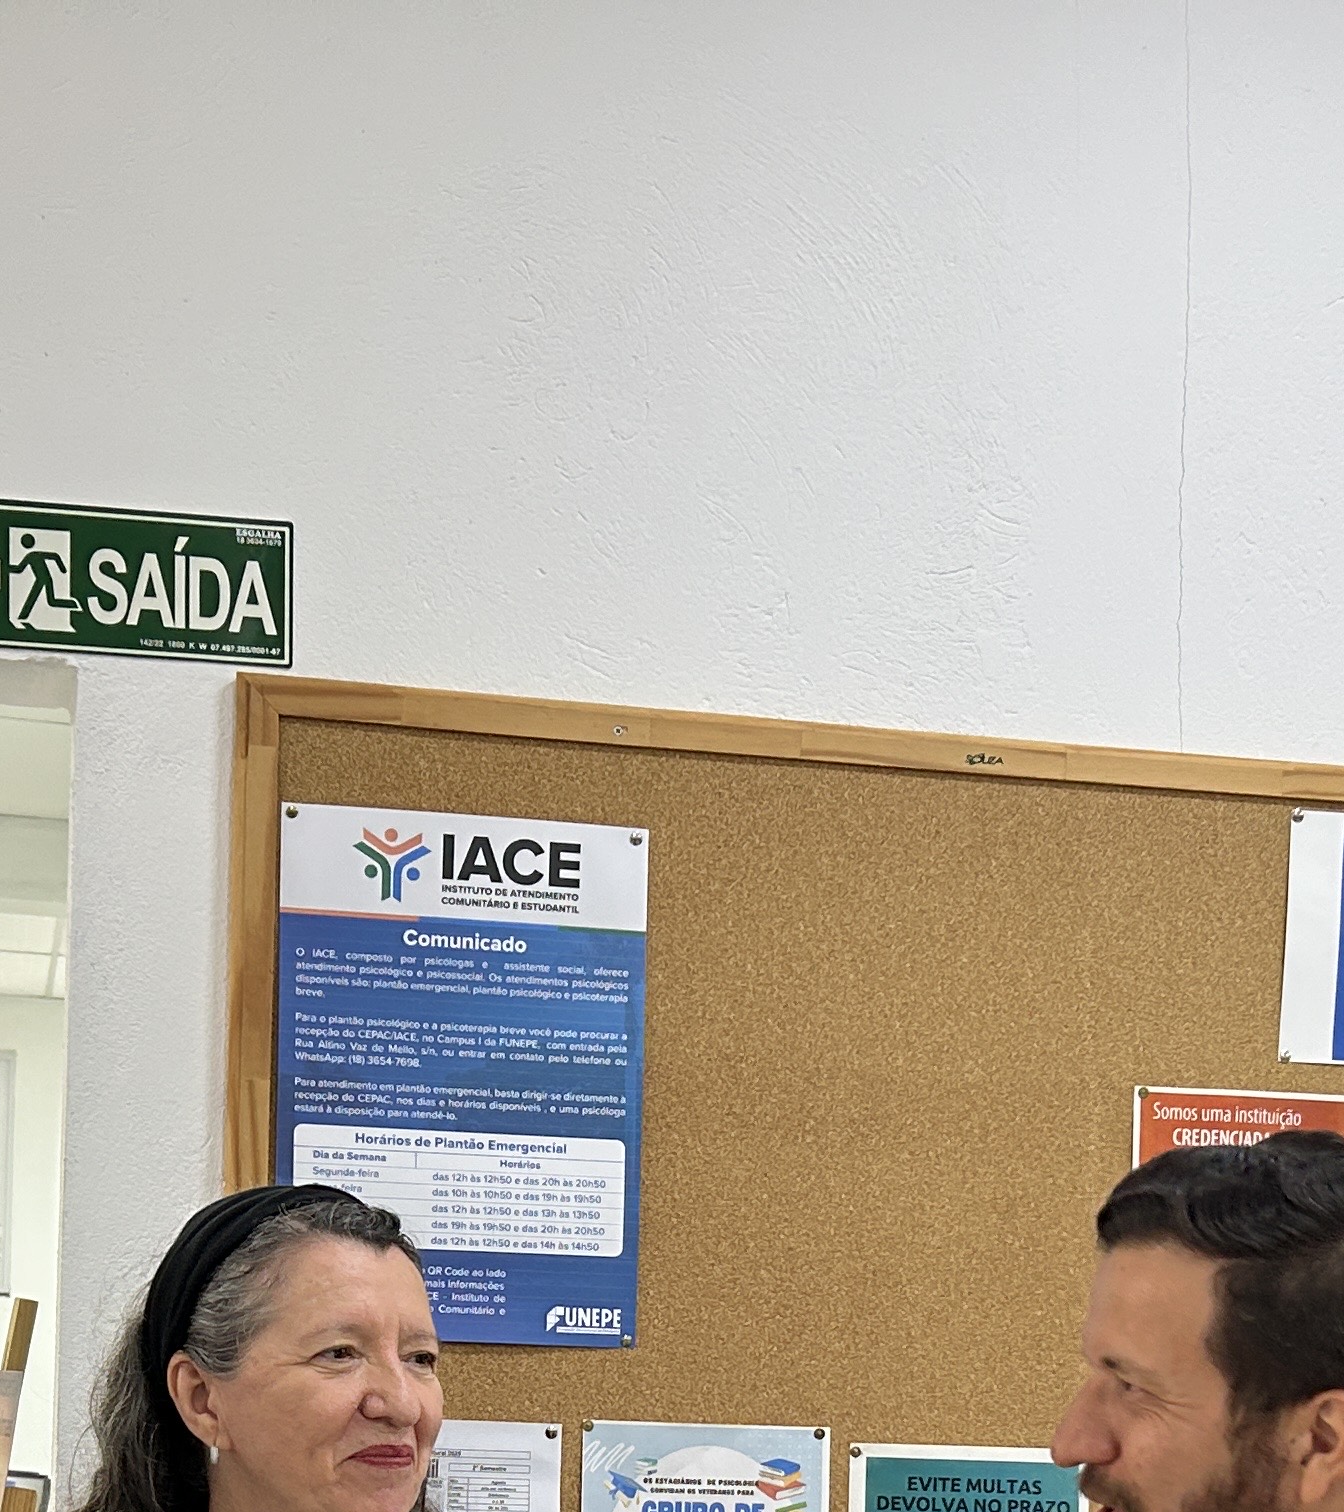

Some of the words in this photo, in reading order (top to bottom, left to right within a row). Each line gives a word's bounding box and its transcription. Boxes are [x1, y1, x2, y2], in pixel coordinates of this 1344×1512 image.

[87, 536, 278, 635] SAÍDA
[442, 834, 581, 888] IACE
[442, 885, 492, 896] INSTITUTO
[495, 888, 507, 896] DE
[510, 890, 579, 901] ATENDIMENTO
[441, 897, 510, 909] COMUNITÁRIO
[513, 901, 518, 909] E
[521, 902, 579, 913] ESTUDANTIL
[403, 929, 527, 953] Comunicado
[1153, 1102, 1198, 1121] Somos
[1202, 1108, 1231, 1122] uma
[1235, 1106, 1301, 1129] instituição
[355, 1133, 411, 1146] Horários
[415, 1136, 431, 1147] de
[435, 1137, 484, 1150] Plantão
[488, 1140, 567, 1155] Emergencial
[1173, 1128, 1270, 1146] CREDENCIAD
[313, 1150, 329, 1159] Dia
[347, 1152, 386, 1161] Semana
[313, 1166, 379, 1178] Segunda-feira
[500, 1160, 541, 1170] Horários
[433, 1174, 449, 1182] das
[452, 1174, 468, 1182] 12h
[471, 1175, 481, 1183] às
[484, 1175, 512, 1184] 12h50
[523, 1177, 539, 1186] das
[542, 1178, 560, 1186] 20h
[563, 1178, 573, 1187] às
[576, 1179, 606, 1188] 20h50
[428, 1266, 442, 1275] QR
[445, 1267, 469, 1276] Code
[486, 1268, 506, 1278] lado
[452, 1293, 489, 1302] Instituto
[494, 1294, 506, 1303] de
[438, 1305, 494, 1315] Comunitário
[546, 1306, 622, 1332] FUNEPE
[908, 1476, 961, 1492] EVITE
[966, 1478, 1042, 1494] MULTAS
[877, 1495, 968, 1512] DEVOLVA
